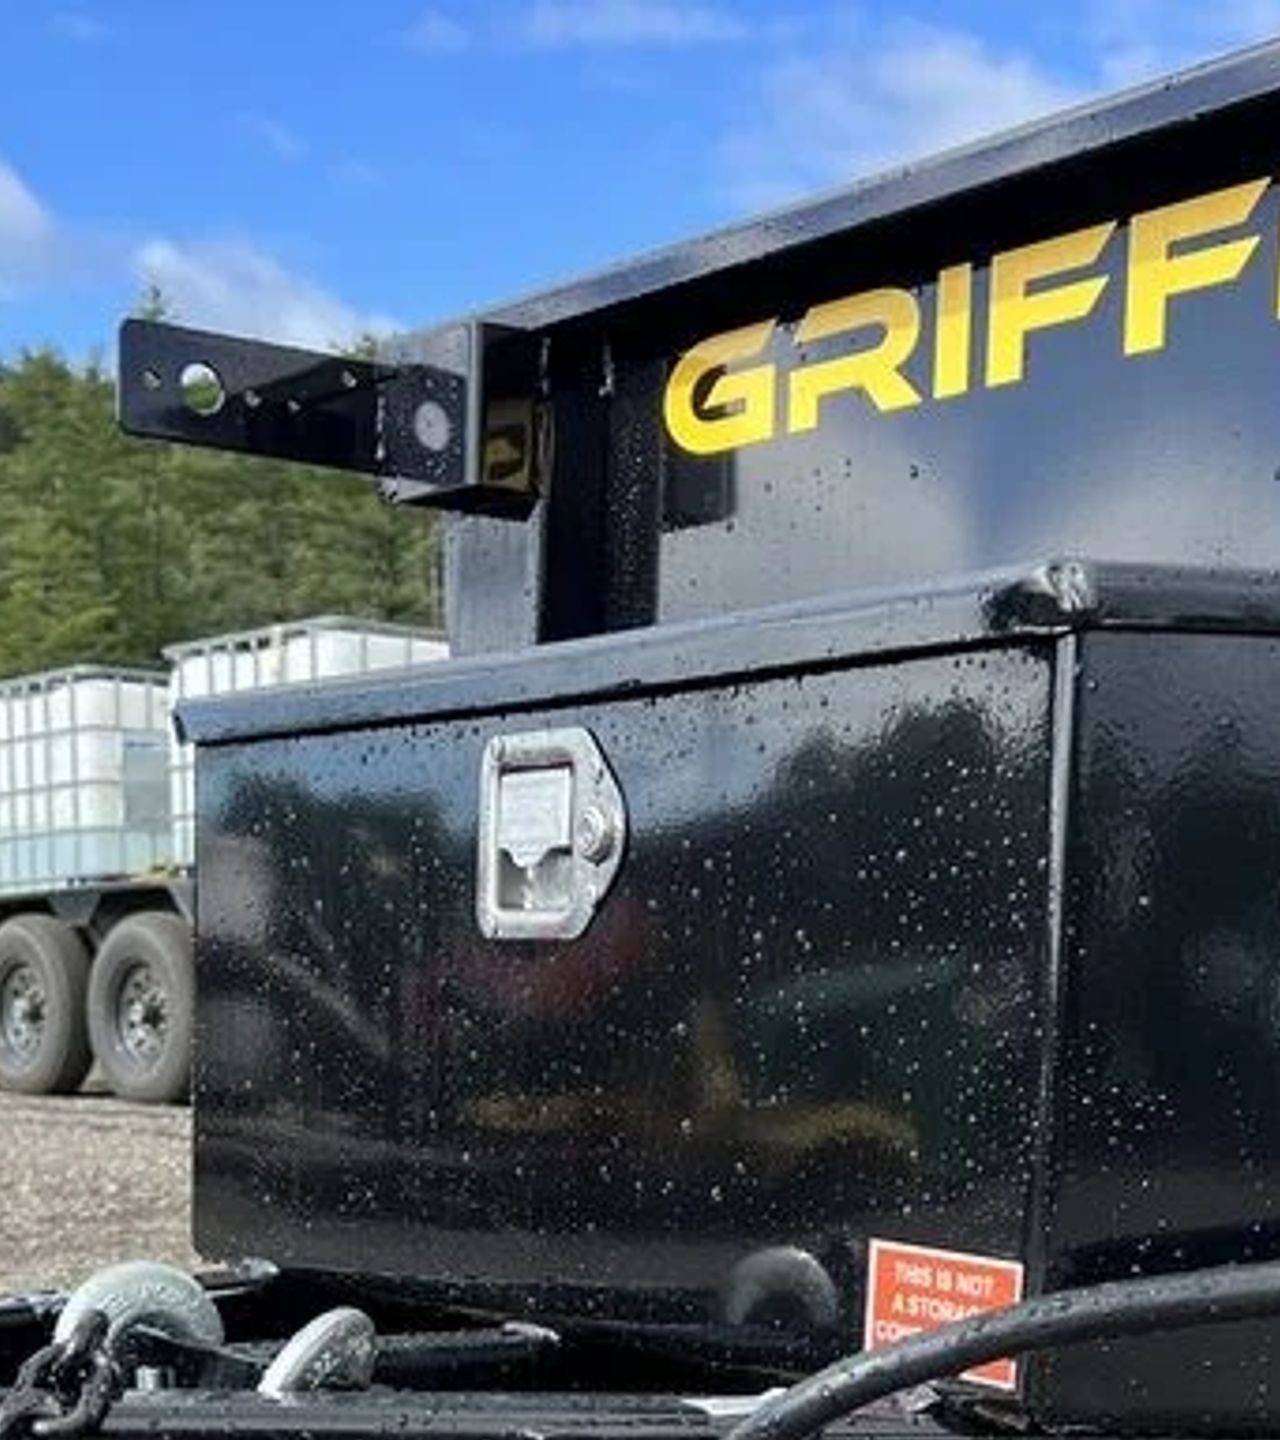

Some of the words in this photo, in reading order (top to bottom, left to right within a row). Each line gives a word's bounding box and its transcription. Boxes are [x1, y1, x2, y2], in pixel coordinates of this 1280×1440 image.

[894, 1260, 933, 1287] THIS
[936, 1268, 952, 1292] IS
[954, 1273, 994, 1298] NOT
[892, 1294, 904, 1313] A
[906, 1295, 982, 1321] STORA
